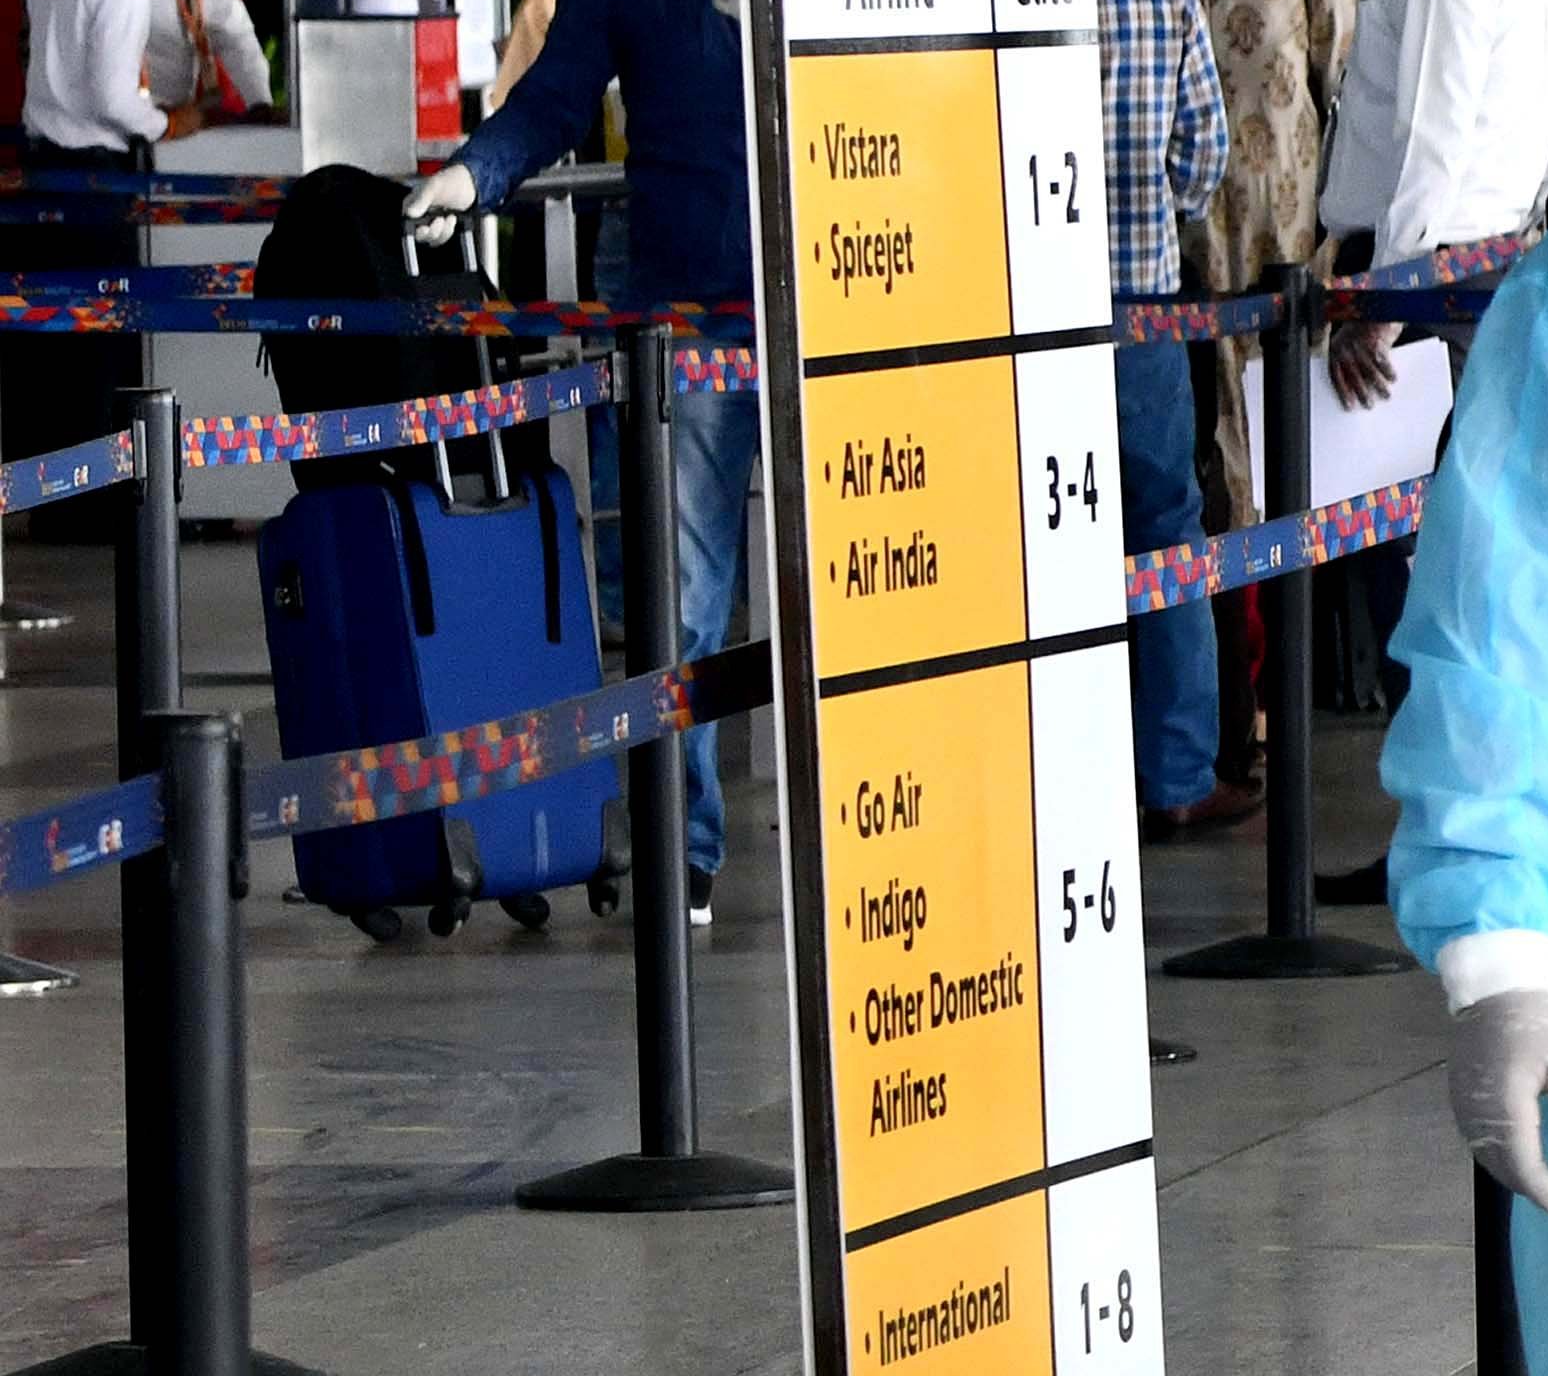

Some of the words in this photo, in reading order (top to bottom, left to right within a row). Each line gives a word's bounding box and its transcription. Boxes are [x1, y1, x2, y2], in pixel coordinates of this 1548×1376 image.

[823, 123, 901, 180] Vistara
[830, 218, 914, 298] Spicejet
[841, 439, 874, 500] Air
[879, 433, 926, 494] Asia
[846, 537, 878, 599] Air
[884, 530, 938, 593] India
[856, 780, 885, 840] Go
[890, 771, 923, 832] Air
[860, 878, 928, 952] Indigo
[865, 982, 925, 1047] Other
[930, 952, 1025, 1030] Domestic
[870, 1068, 948, 1138] Airlines
[878, 1266, 1012, 1368] International
